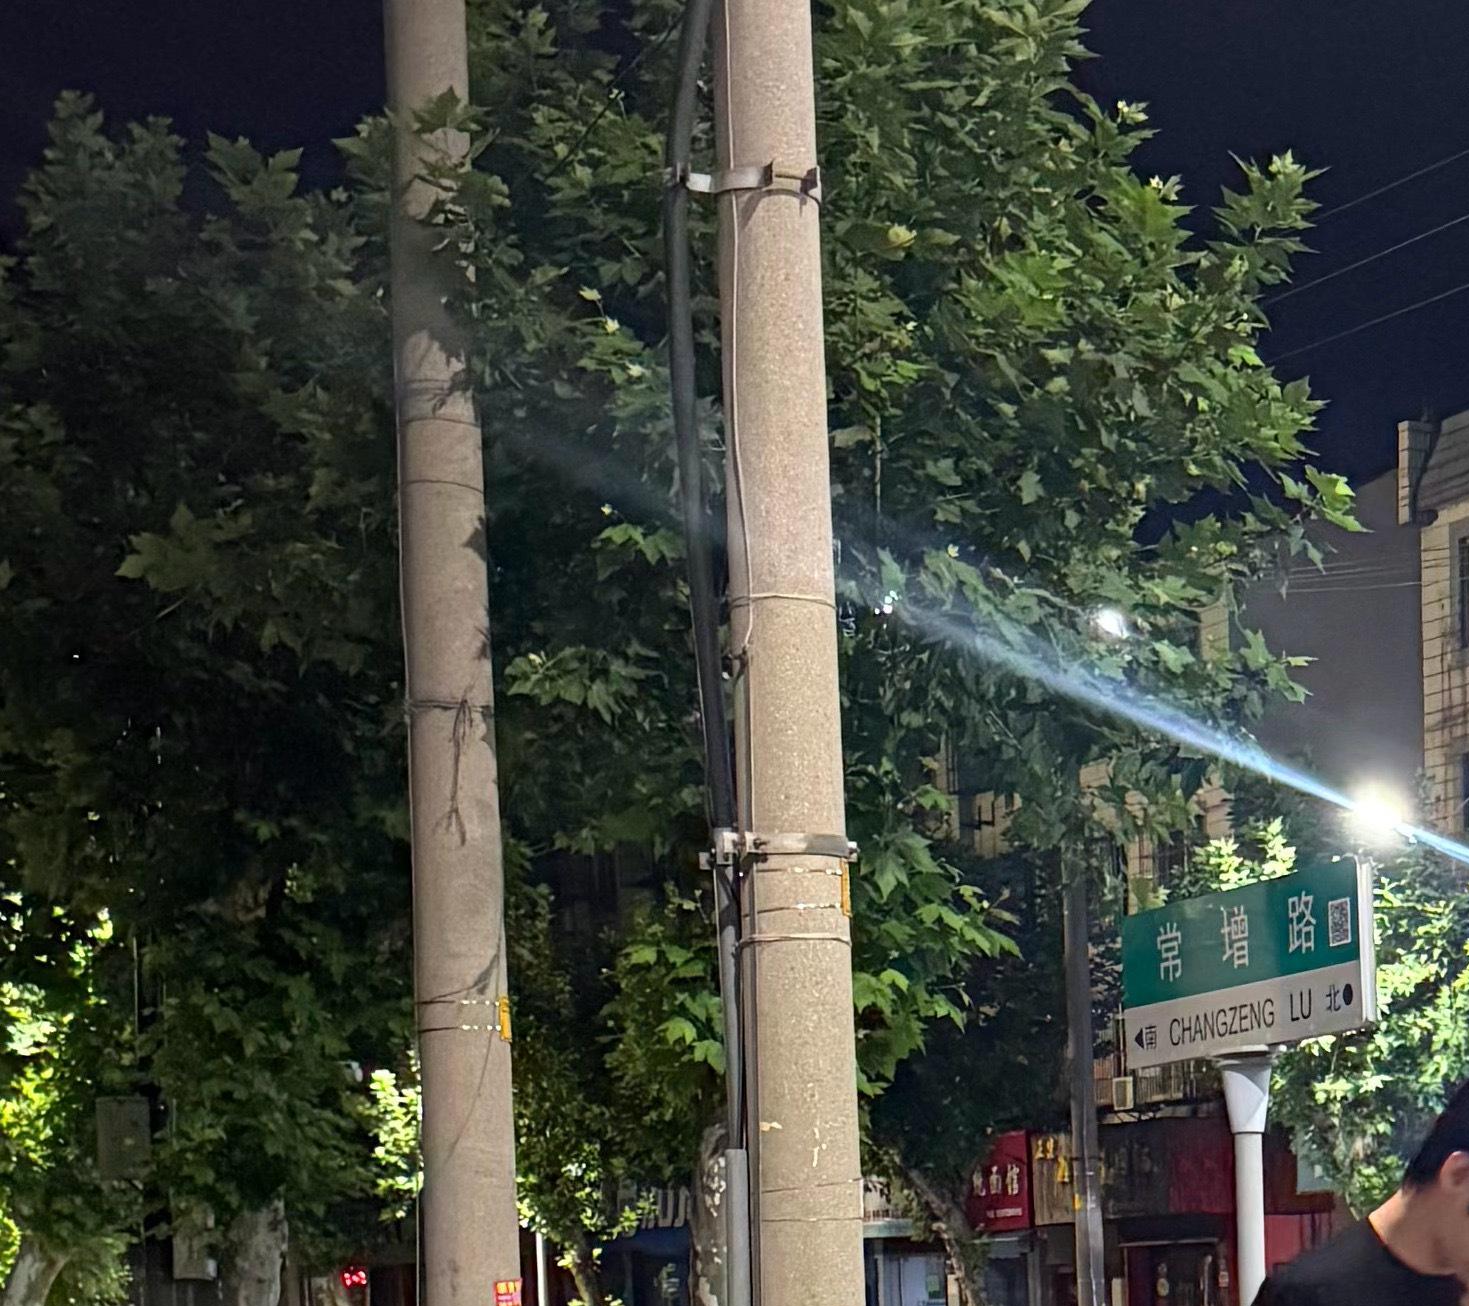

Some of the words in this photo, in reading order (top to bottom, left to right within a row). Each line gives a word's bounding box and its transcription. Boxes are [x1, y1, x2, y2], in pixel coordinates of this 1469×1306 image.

[1156, 890, 1317, 982] 常增路
[1144, 1024, 1158, 1051] 南
[1169, 998, 1275, 1047] CHANGZENG
[1289, 988, 1312, 1022] LU
[1325, 984, 1341, 1013] 北
